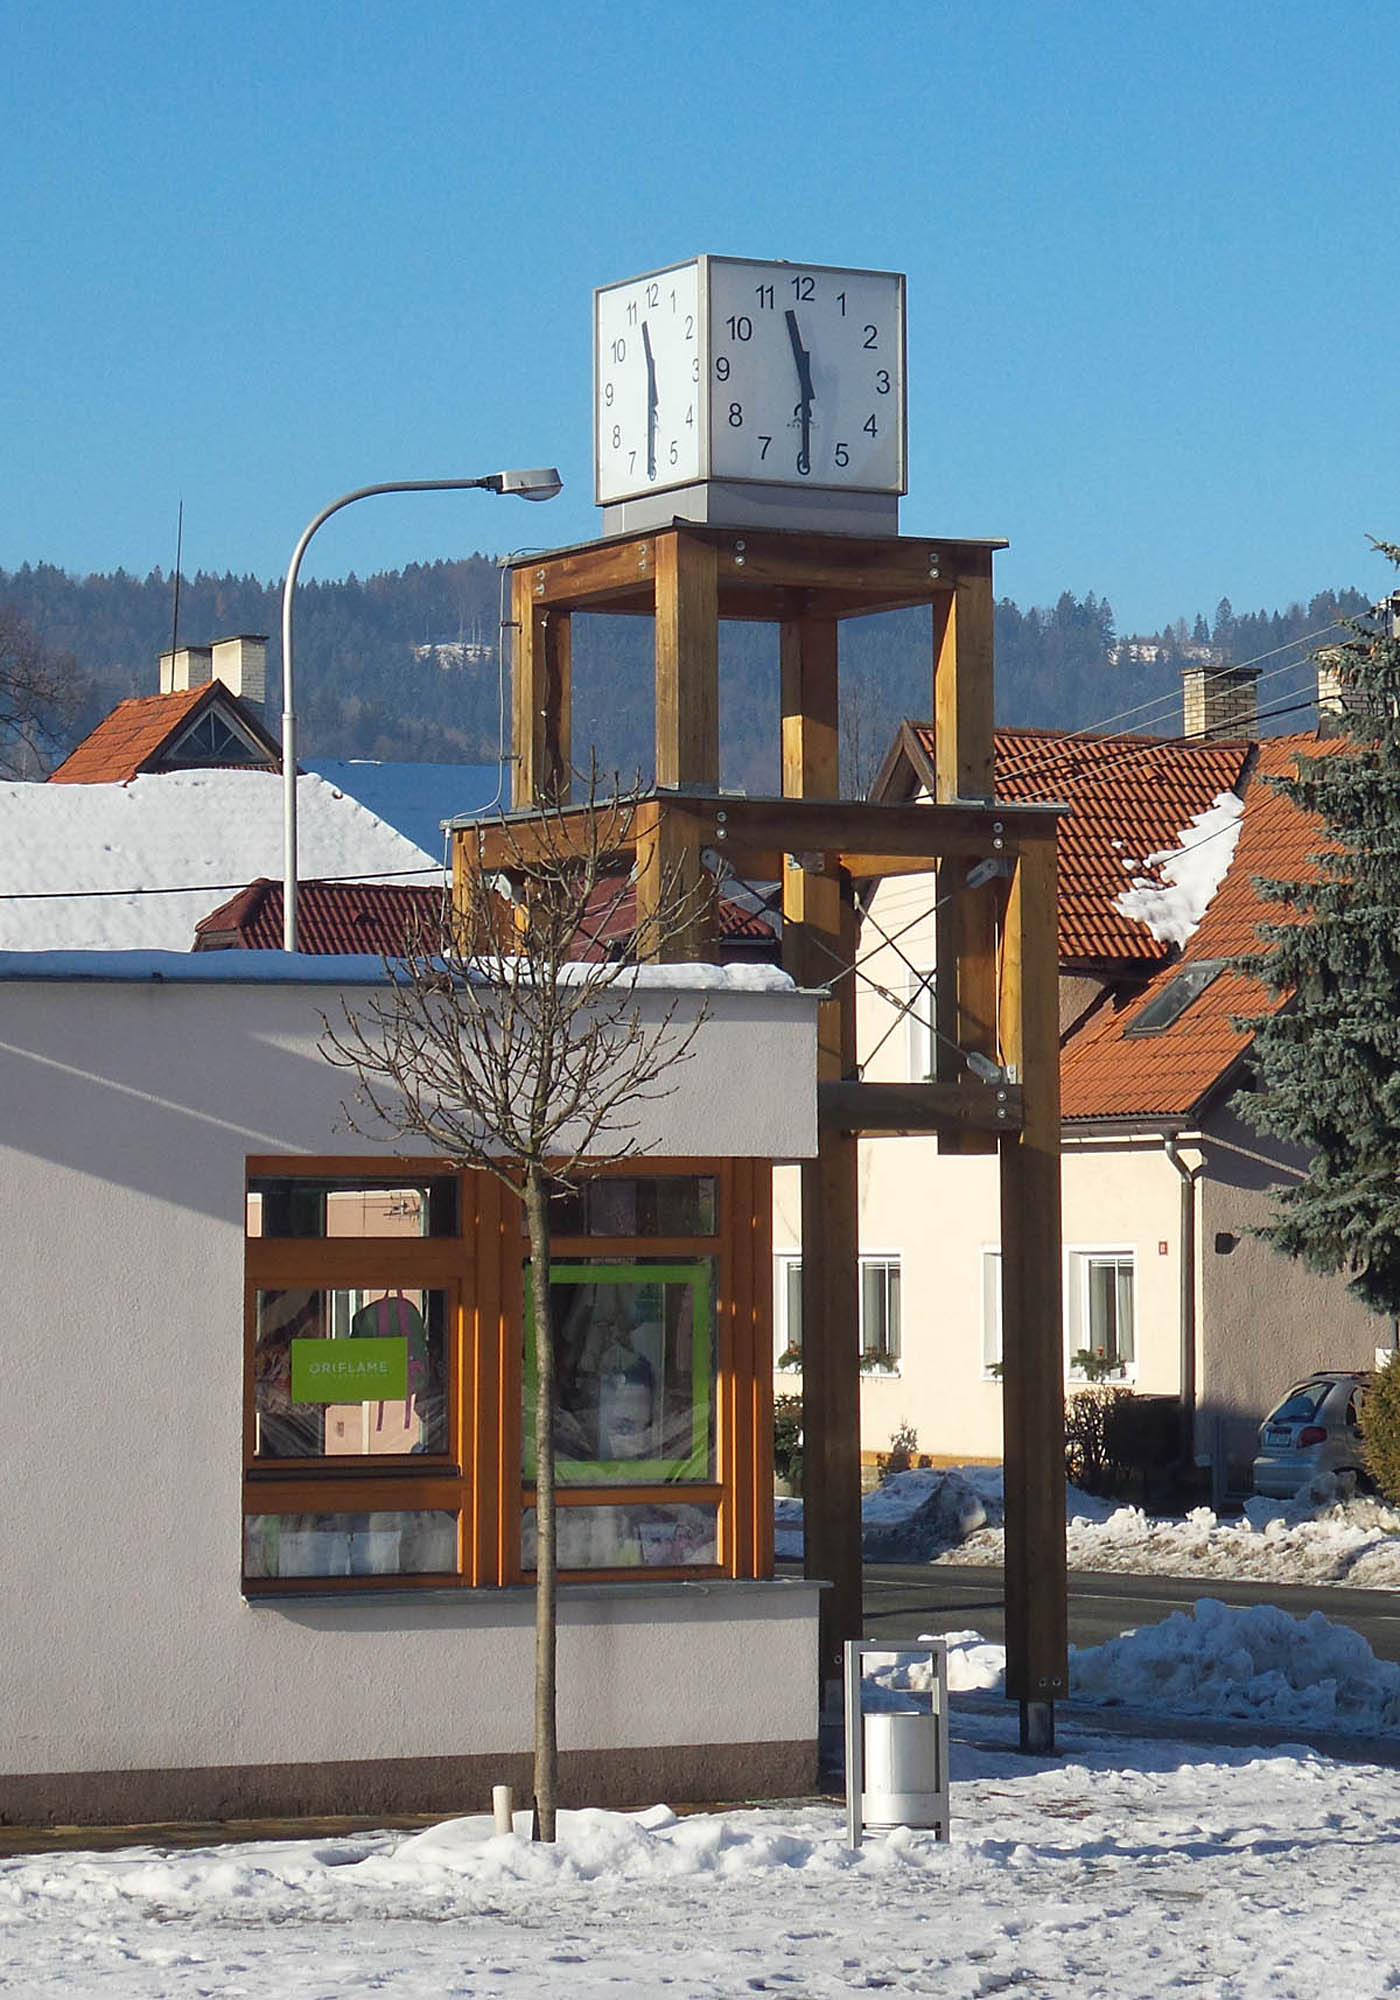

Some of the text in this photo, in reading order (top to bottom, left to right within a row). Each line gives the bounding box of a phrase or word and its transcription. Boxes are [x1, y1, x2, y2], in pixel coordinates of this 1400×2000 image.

[646, 283, 658, 308] 12
[756, 285, 773, 309] 11
[792, 276, 815, 301] 12
[627, 302, 637, 325] 11
[837, 292, 845, 316] 1
[686, 315, 693, 340] 2
[726, 316, 752, 341] 10
[864, 325, 877, 349] 2
[611, 339, 625, 363] 10
[692, 359, 699, 382] 3
[716, 357, 730, 381] 9
[876, 370, 890, 394] 3
[605, 383, 613, 406] 9
[686, 405, 693, 428] 4
[729, 403, 742, 427] 8
[864, 414, 878, 438] 4
[613, 425, 620, 448] 8
[758, 436, 772, 460] 7
[629, 451, 636, 475] 7
[670, 441, 677, 465] 5
[835, 443, 849, 467] 5
[309, 1361, 389, 1375] ORIFLAME
